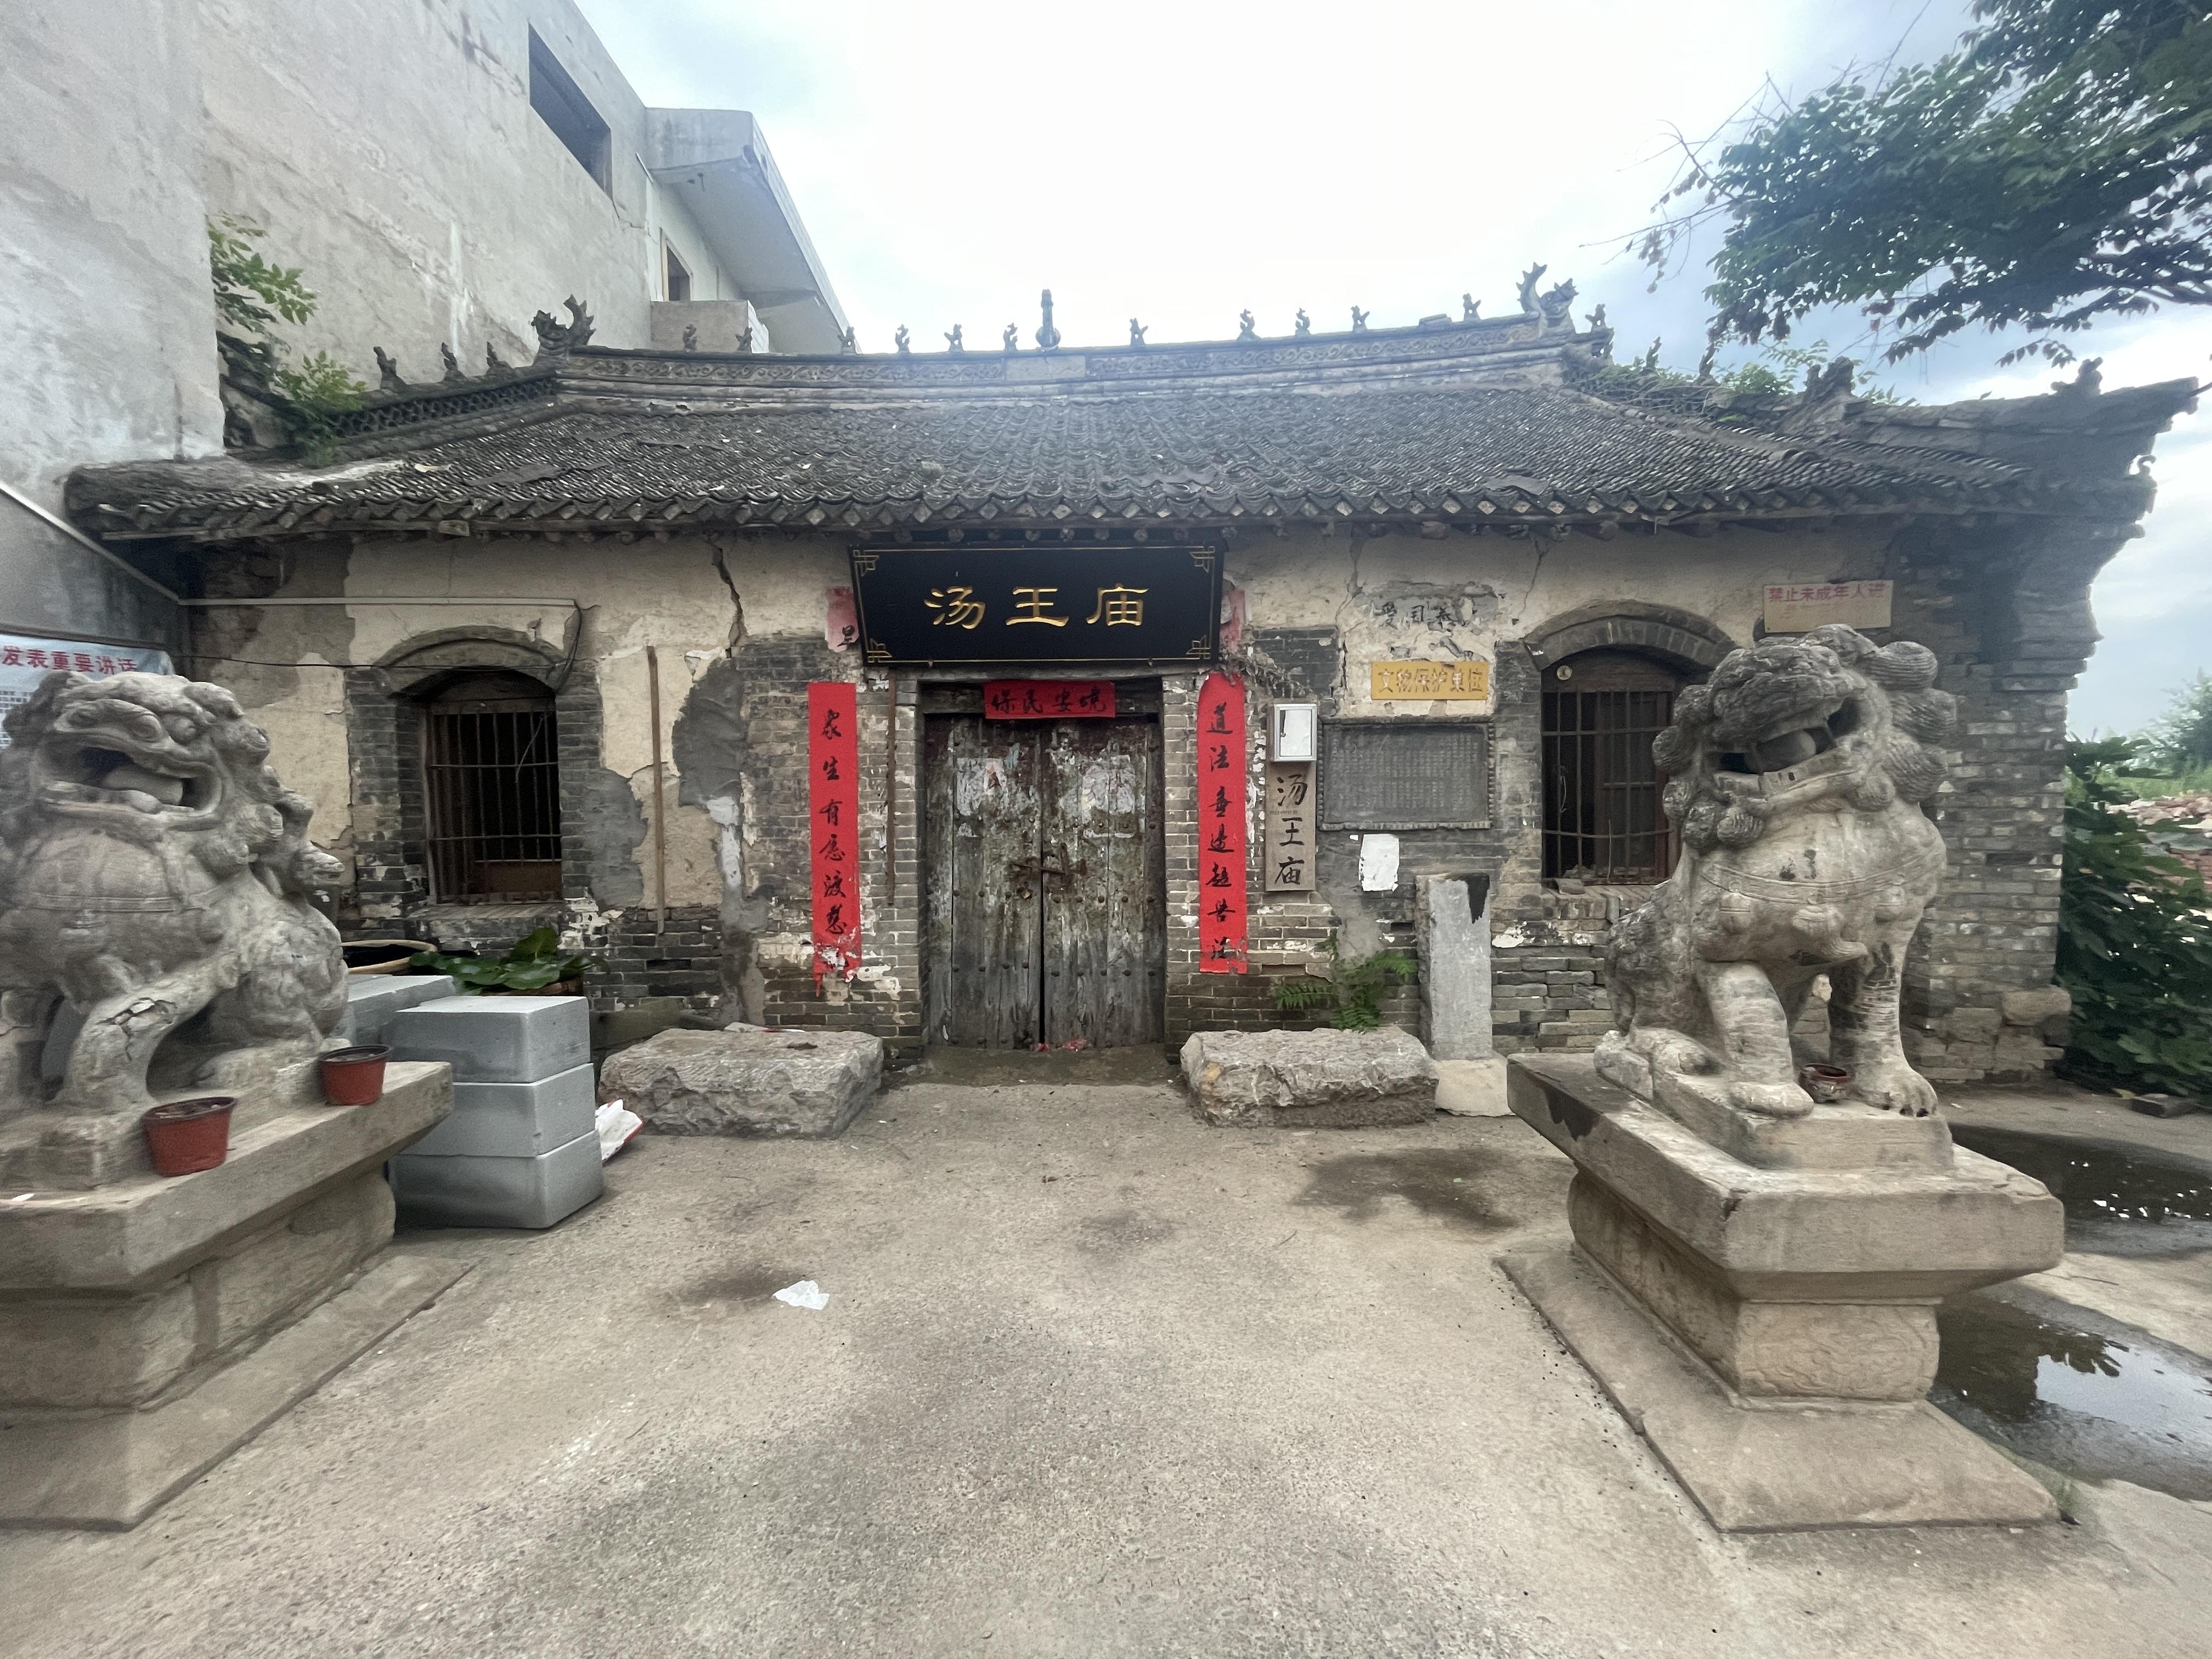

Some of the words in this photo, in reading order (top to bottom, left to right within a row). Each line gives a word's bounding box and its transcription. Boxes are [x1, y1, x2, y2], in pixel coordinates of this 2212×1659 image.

[924, 583, 1149, 629] 汤王庙
[3, 645, 137, 675] 发表重要讲话
[1274, 774, 1308, 885] 汤王庙
